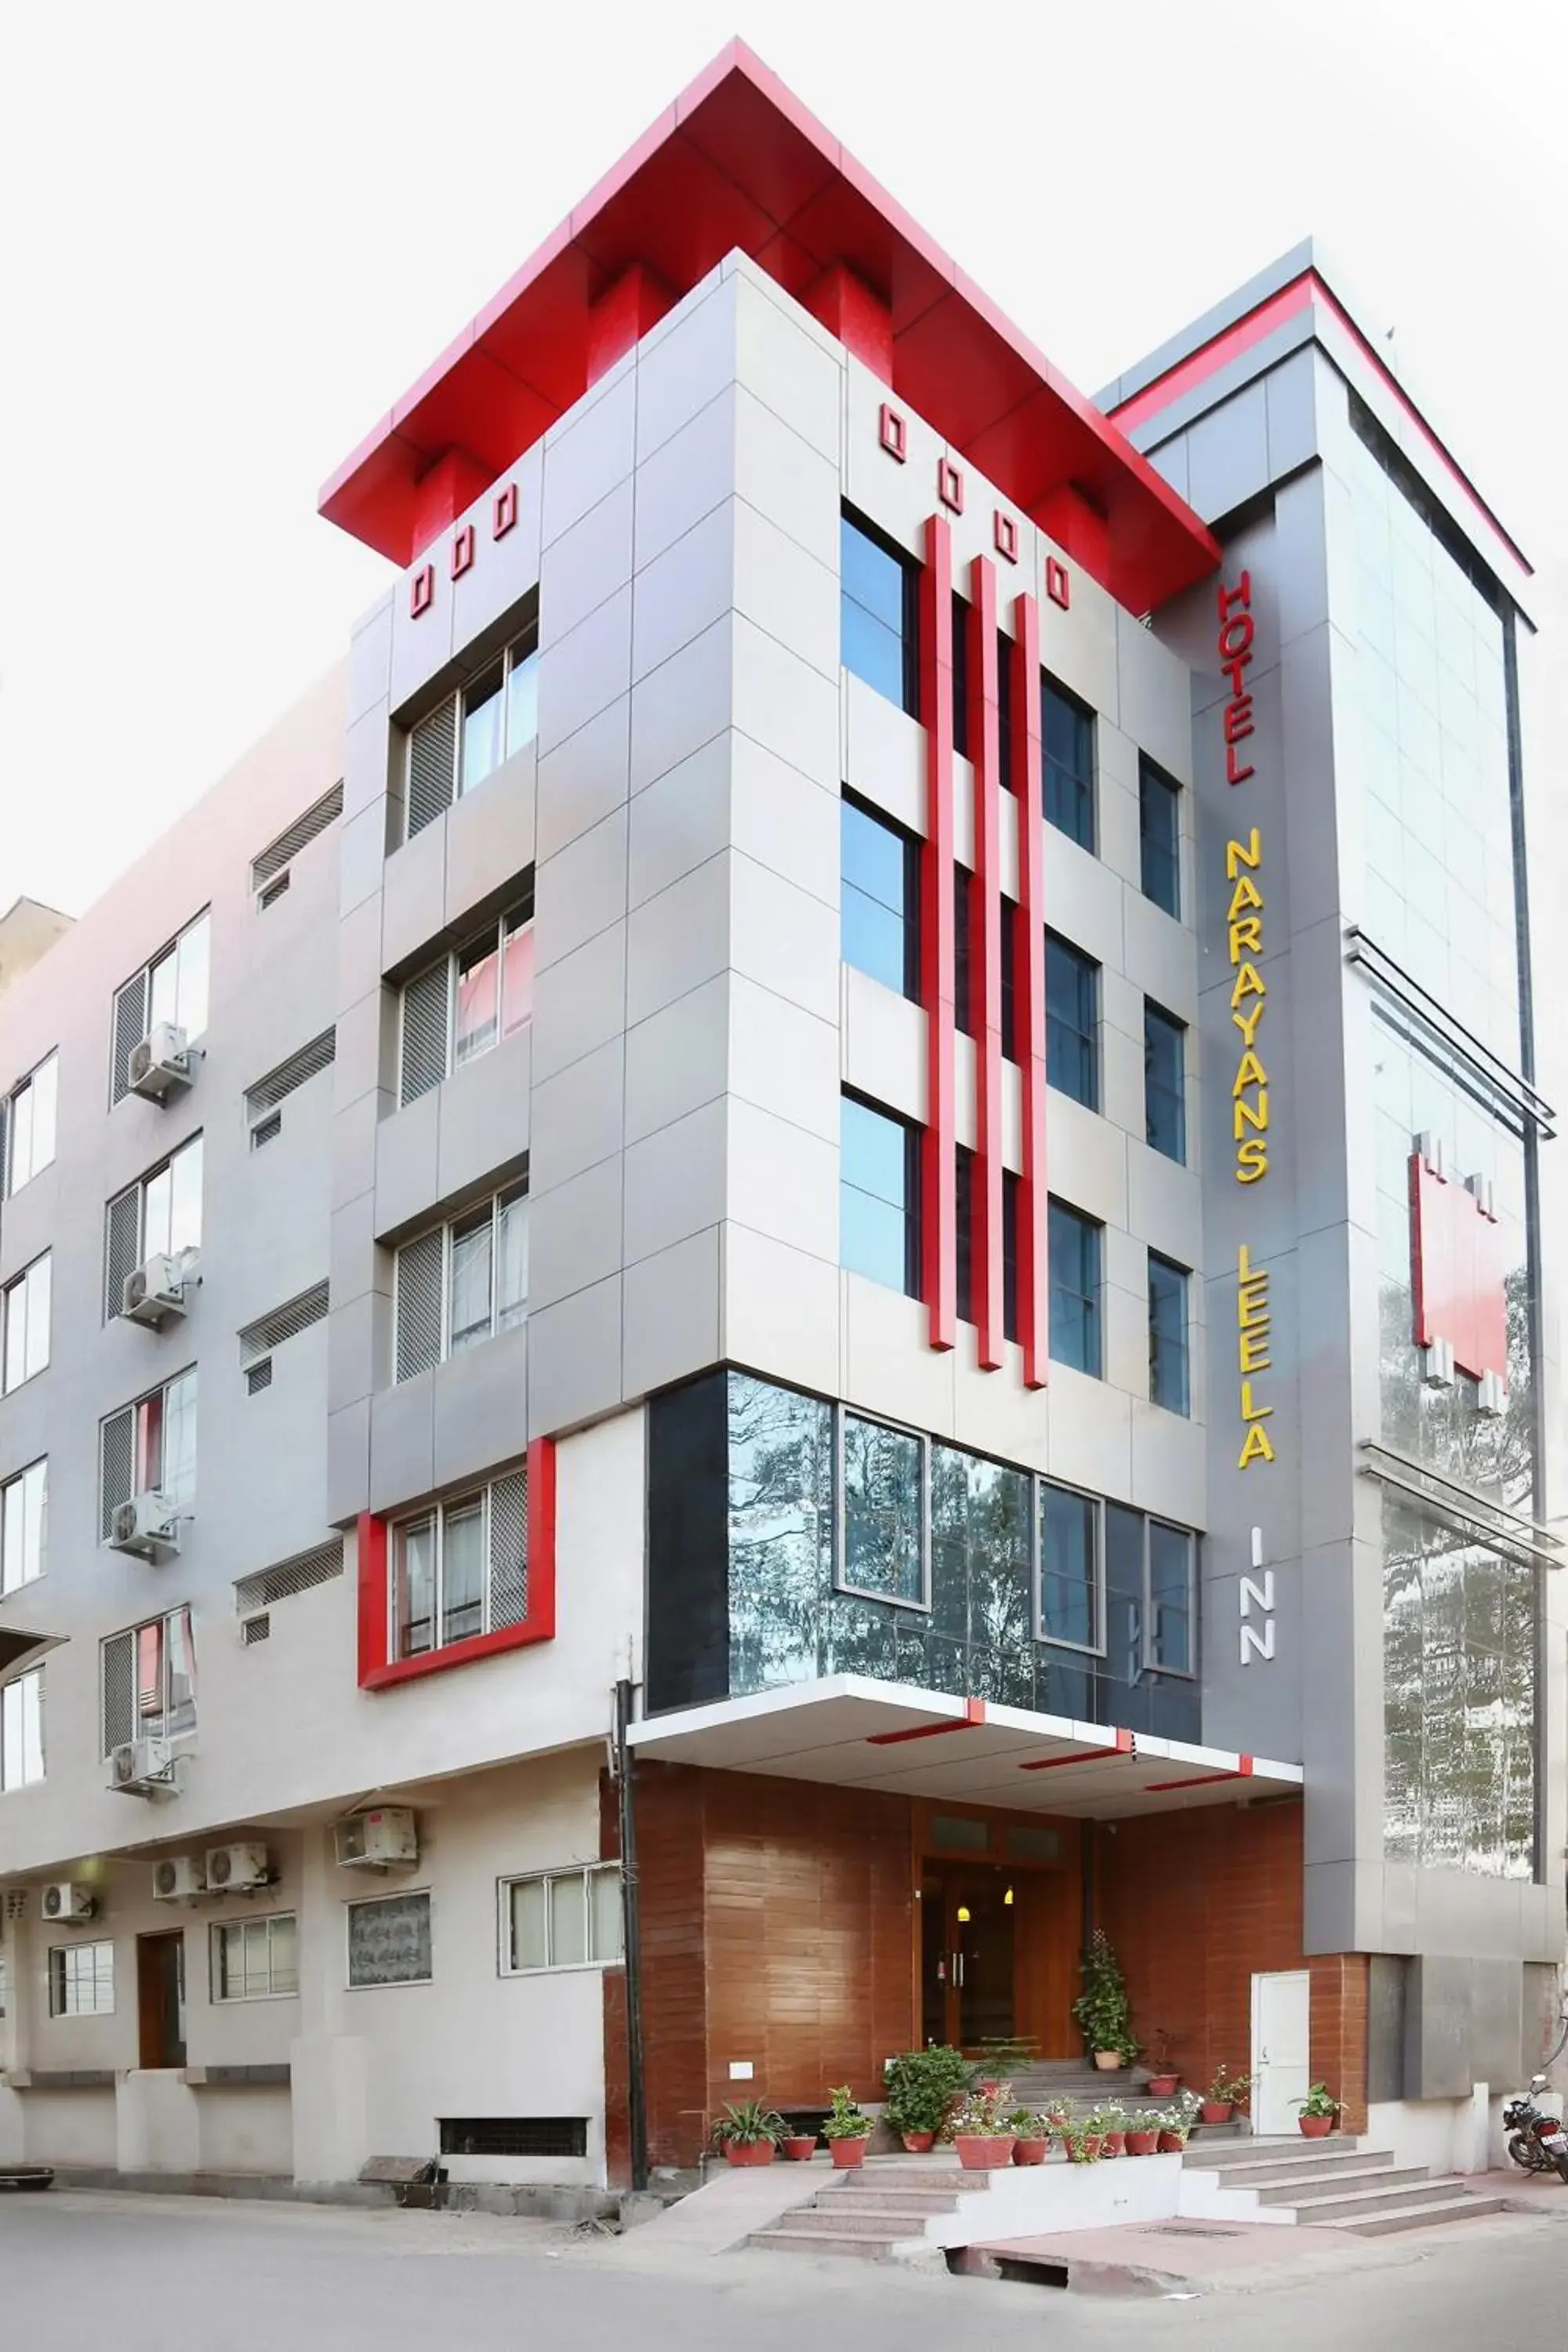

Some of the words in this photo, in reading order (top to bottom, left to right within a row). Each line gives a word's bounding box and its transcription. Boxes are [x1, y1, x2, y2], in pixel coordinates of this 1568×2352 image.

[1218, 570, 1254, 785] HOTEL
[1226, 827, 1269, 1182] NARAYANS
[1237, 1244, 1276, 1469] LEELA
[1240, 1526, 1275, 1665] INN
